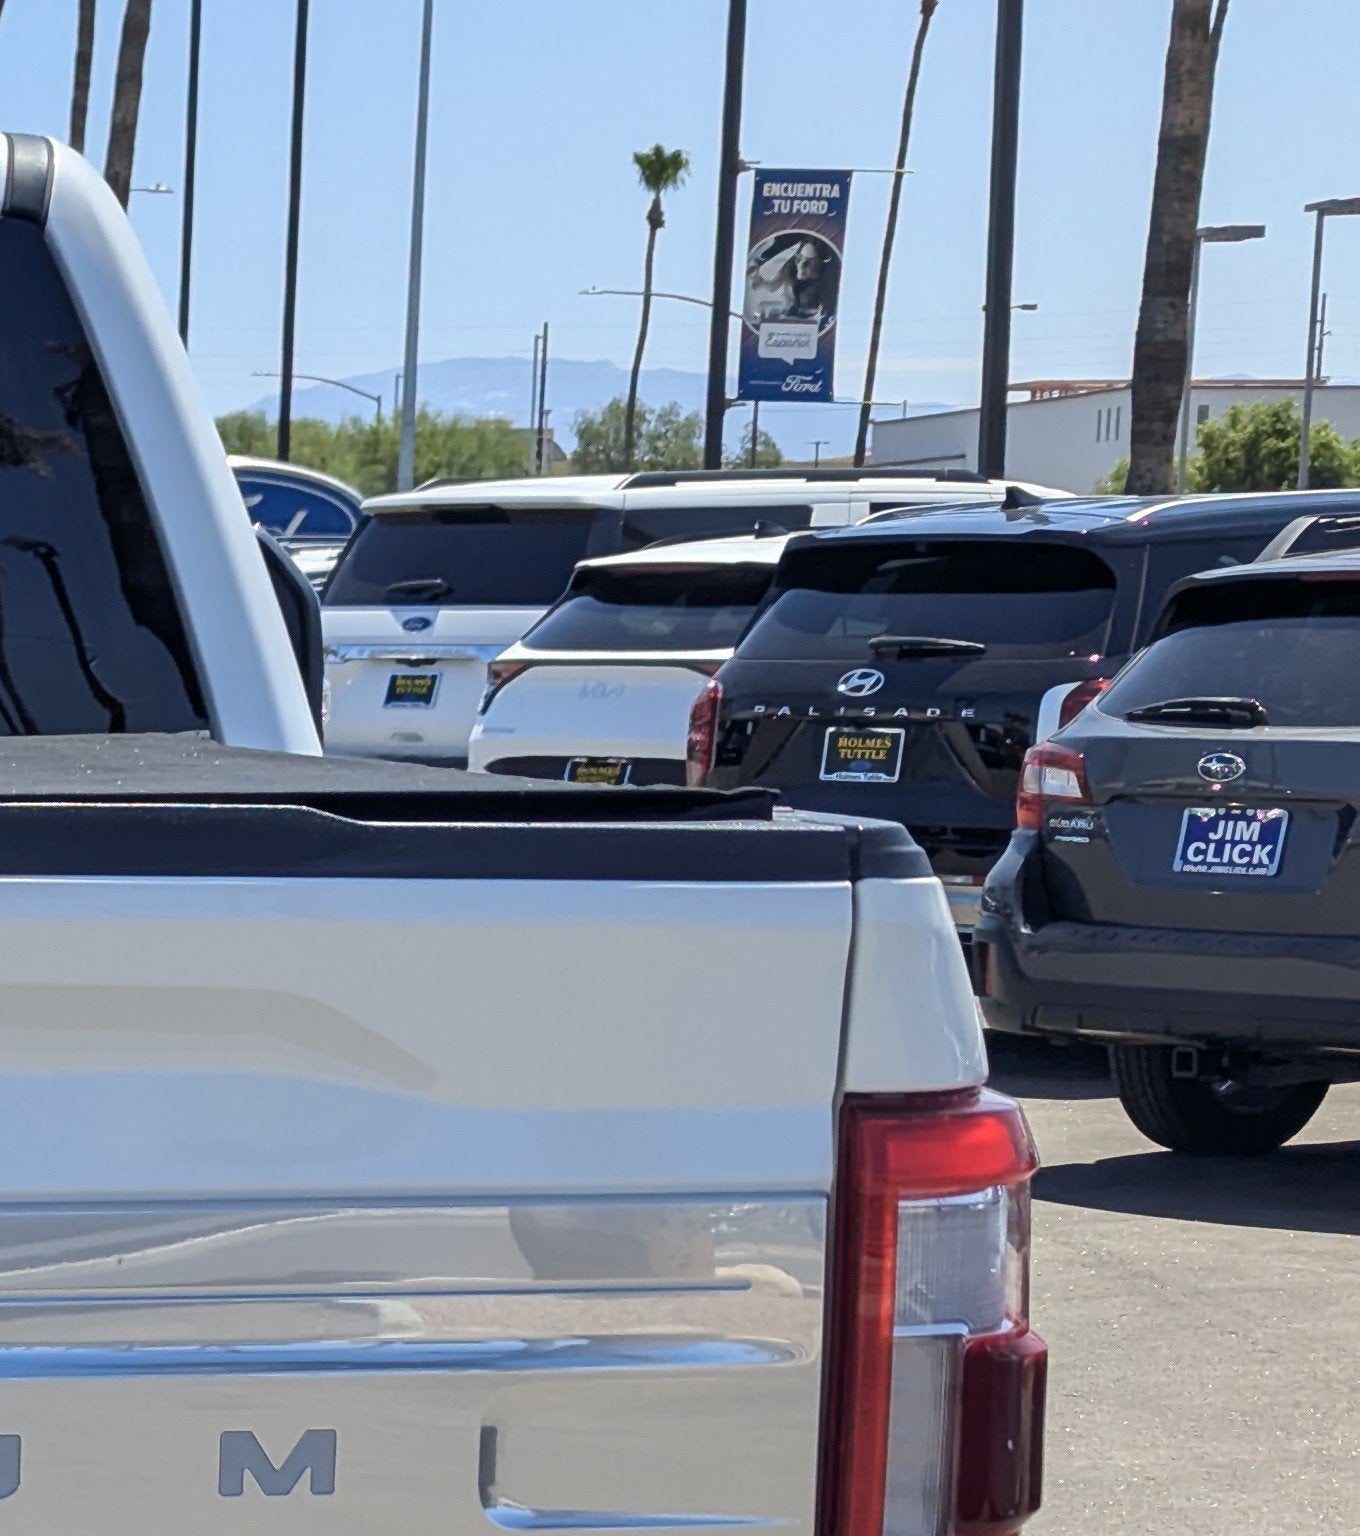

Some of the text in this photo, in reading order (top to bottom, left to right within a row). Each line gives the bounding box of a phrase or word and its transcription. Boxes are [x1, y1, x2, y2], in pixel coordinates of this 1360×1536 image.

[763, 182, 840, 198] ENCUENTRA
[773, 200, 829, 215] TU FORD
[781, 374, 822, 393] Ford
[753, 704, 976, 718] PALISADE
[837, 735, 892, 749] HOLMES
[839, 748, 888, 760] TUTTLE
[1208, 820, 1262, 842] JIM
[1186, 841, 1274, 865] CLICK
